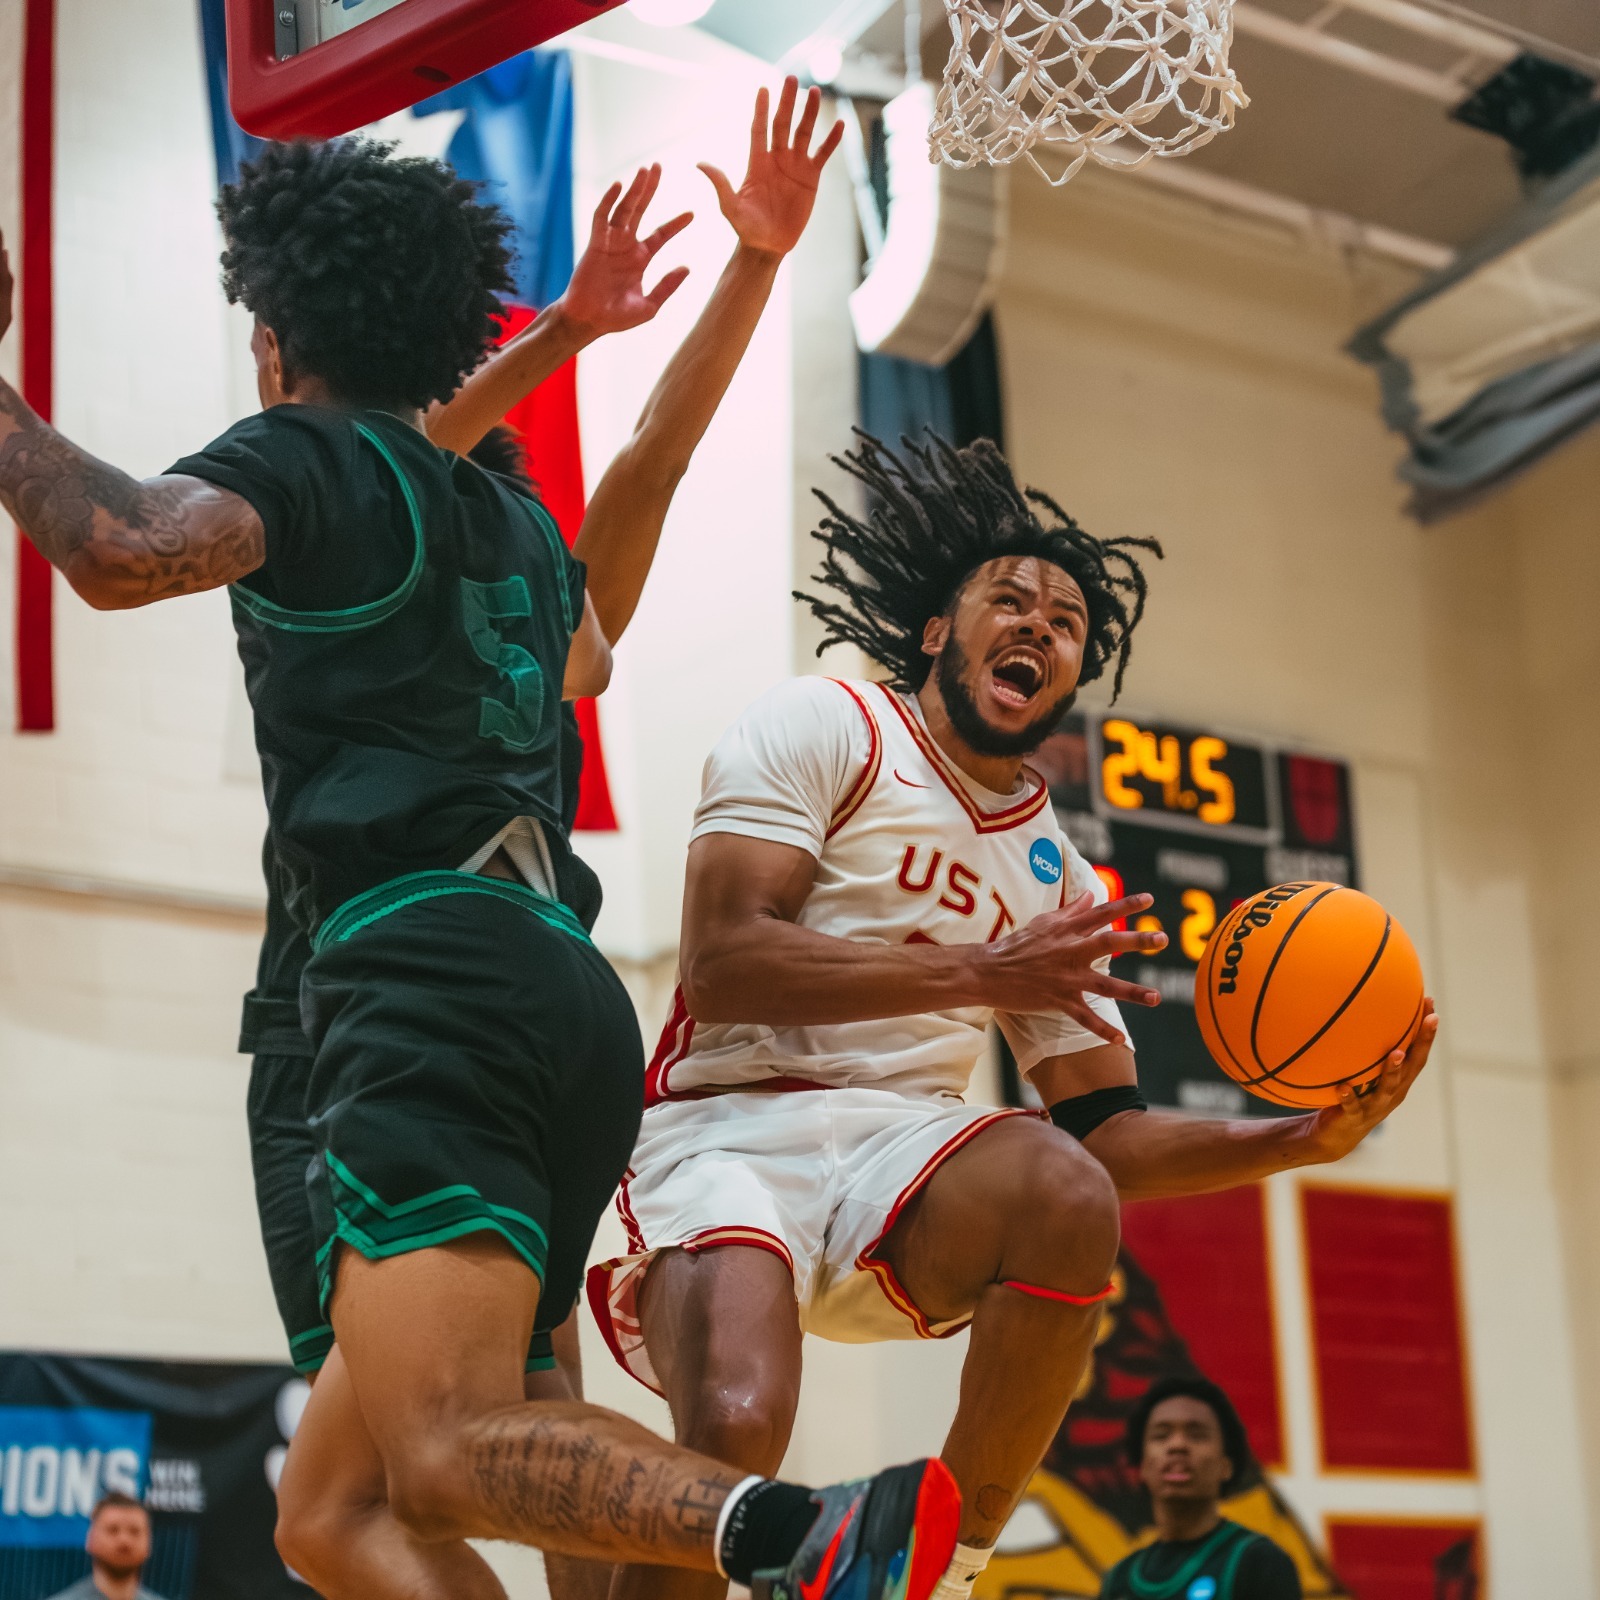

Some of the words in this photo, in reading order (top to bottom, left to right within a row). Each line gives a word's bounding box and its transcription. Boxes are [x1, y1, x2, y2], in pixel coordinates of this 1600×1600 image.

[460, 575, 545, 749] 5
[1032, 853, 1060, 879] NCAA
[1180, 888, 1217, 962] 2
[1218, 882, 1315, 996] Wilson
[0, 1446, 140, 1518] IONS
